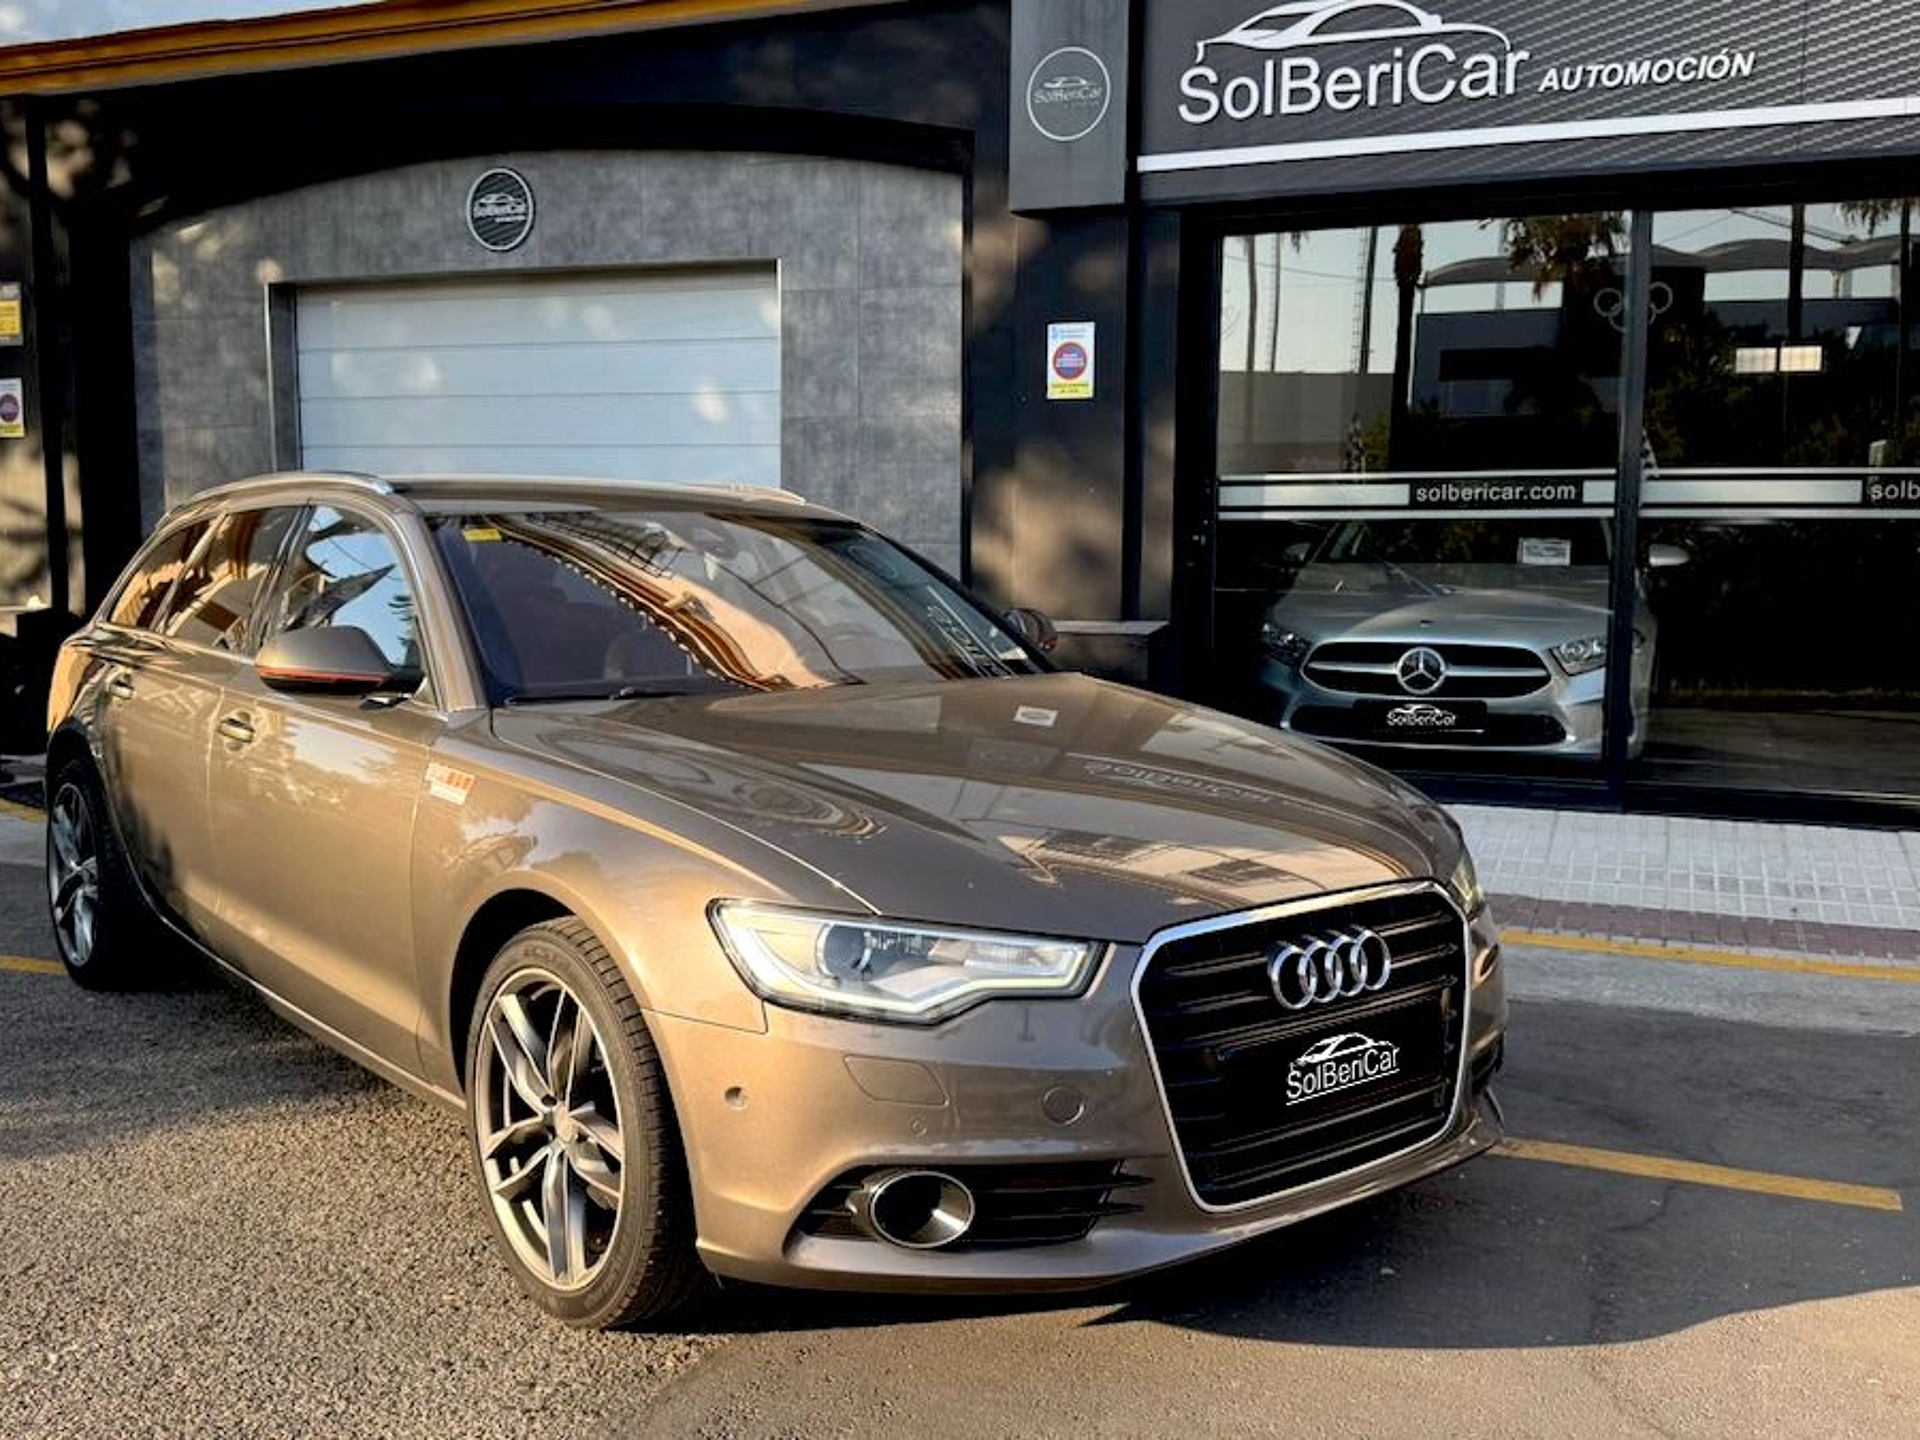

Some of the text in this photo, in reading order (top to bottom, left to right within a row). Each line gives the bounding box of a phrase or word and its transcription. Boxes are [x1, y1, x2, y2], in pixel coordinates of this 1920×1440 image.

[1179, 43, 1756, 123] SolBeriCar AUTOMOCIÓN
[1416, 483, 1576, 502] solbericar.com
[1871, 480, 1920, 500] solb
[1286, 1047, 1400, 1099] SolBeriCar
